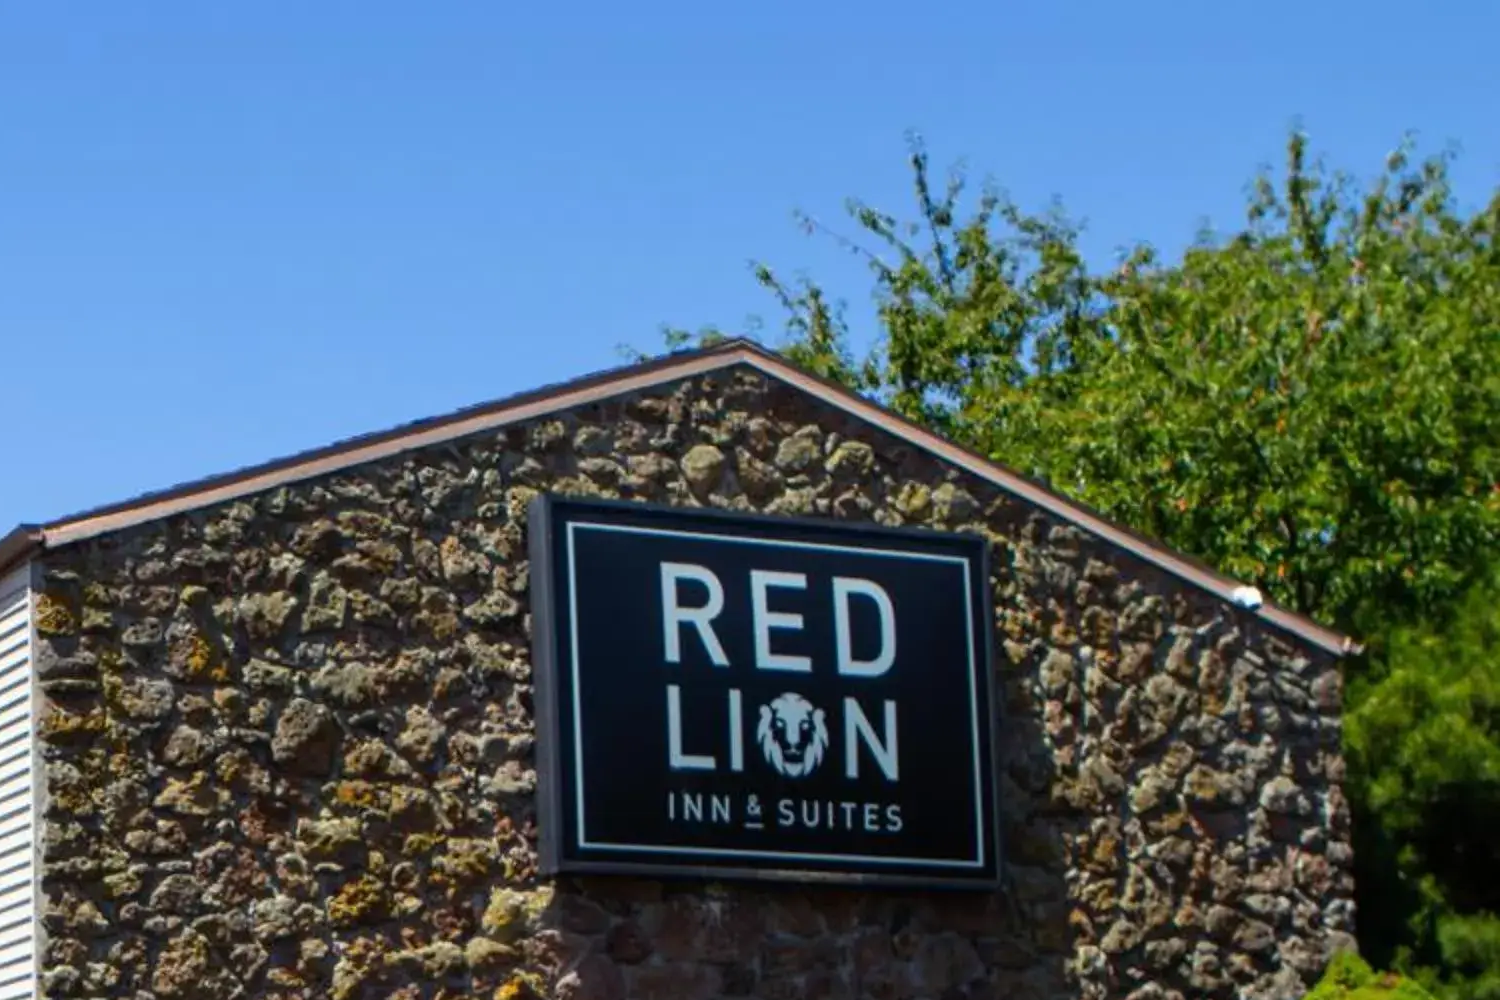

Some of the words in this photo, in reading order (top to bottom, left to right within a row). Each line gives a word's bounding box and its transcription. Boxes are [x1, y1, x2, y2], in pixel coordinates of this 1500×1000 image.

[660, 561, 897, 677] RED
[668, 791, 731, 825] INN
[745, 793, 763, 829] &
[779, 798, 903, 832] SUITES
